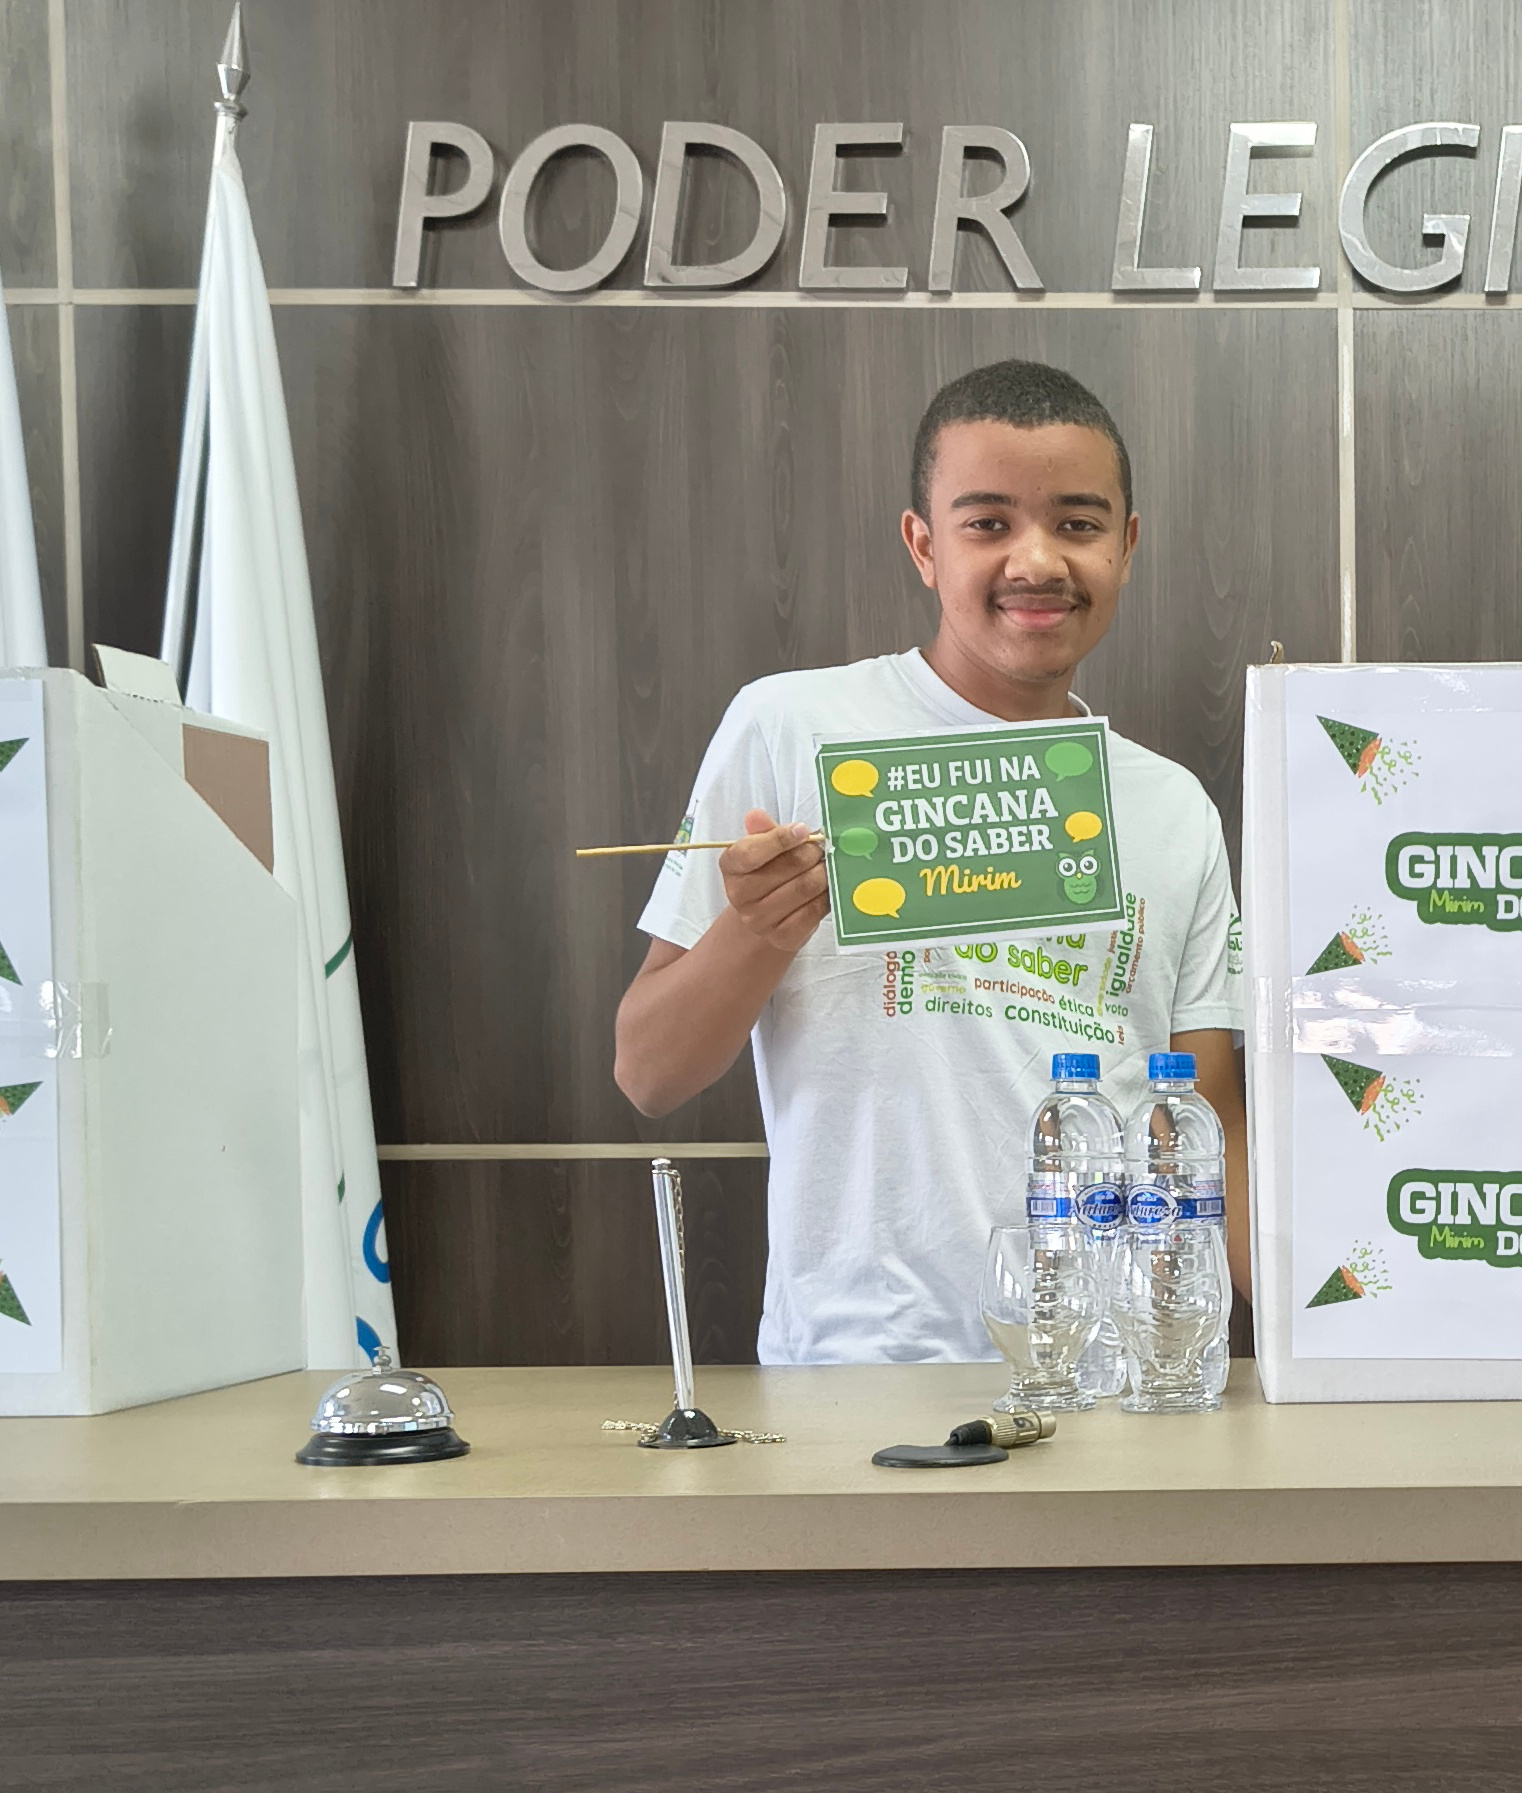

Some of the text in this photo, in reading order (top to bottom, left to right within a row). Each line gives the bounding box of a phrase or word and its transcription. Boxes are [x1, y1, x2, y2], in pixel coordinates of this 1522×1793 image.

[392, 120, 1044, 293] PODER
[887, 754, 1041, 791] #EU FUI NA
[875, 787, 1058, 832] GINCANA
[892, 824, 1053, 864] DO SABER
[919, 864, 1022, 897] Mirim
[1429, 889, 1485, 914] Mirim
[883, 950, 900, 1017] diálogo
[1007, 944, 1089, 987] saber
[974, 976, 1094, 1018] participação ética
[925, 996, 1115, 1044] direitos constituição
[1429, 1225, 1485, 1250] Mirim
